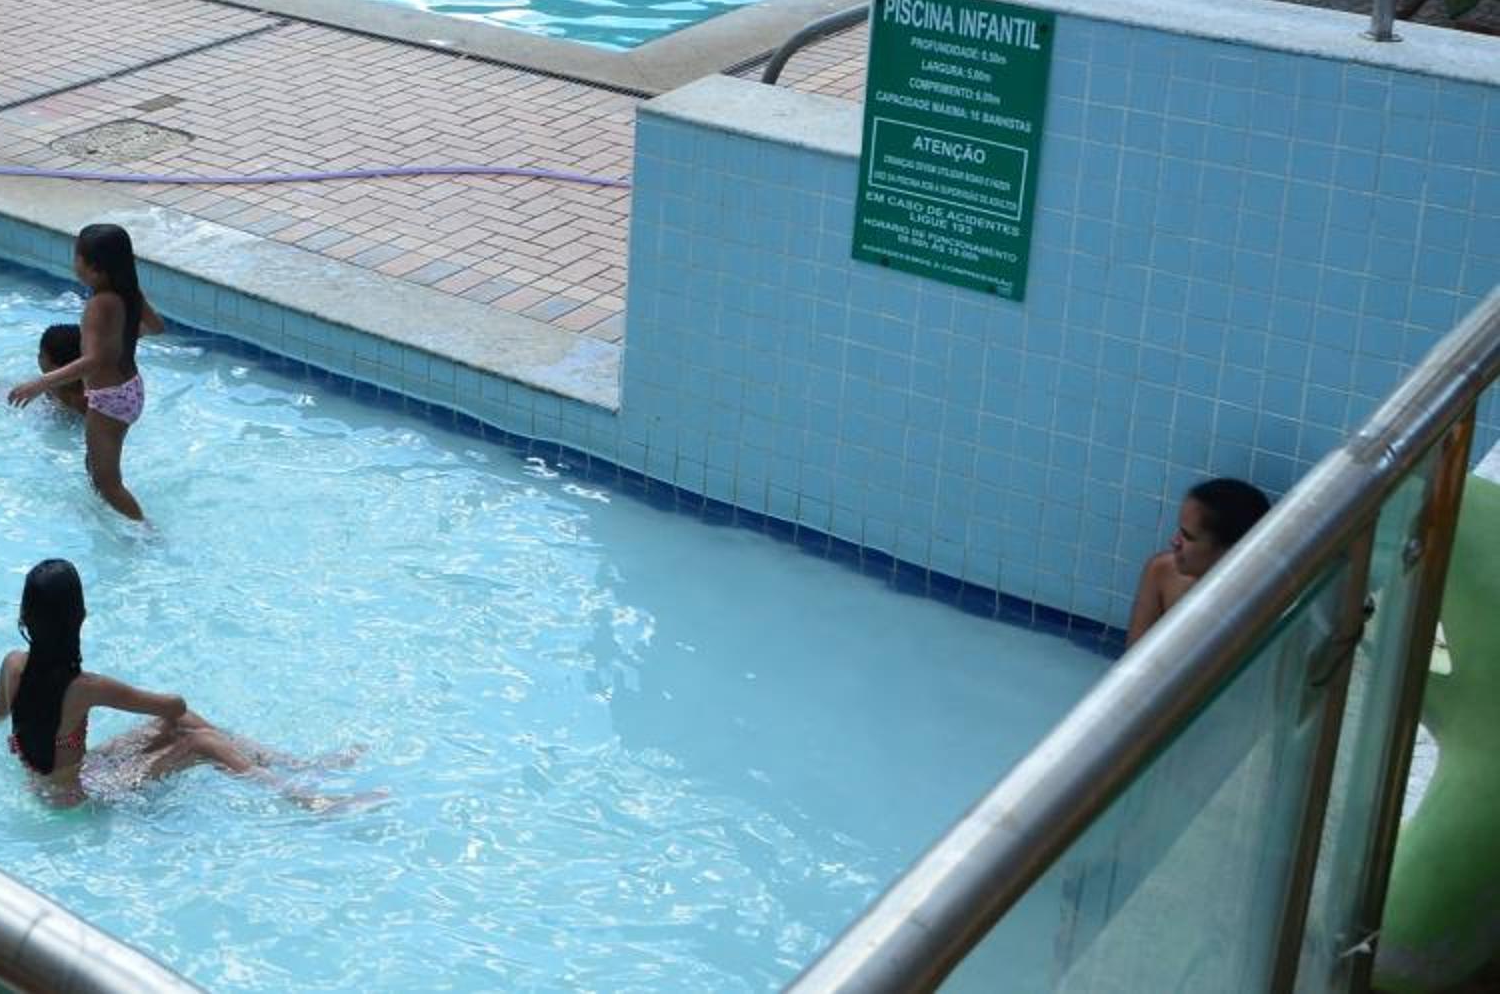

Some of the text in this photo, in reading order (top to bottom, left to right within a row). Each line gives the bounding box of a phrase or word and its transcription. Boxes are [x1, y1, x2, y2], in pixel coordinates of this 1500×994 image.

[959, 9, 1040, 49] INFANTIL
[914, 135, 986, 164] ATENÇÃO
[865, 190, 1019, 236] EM CASO DE ACIDENTES
[908, 211, 947, 229] LIGUE
